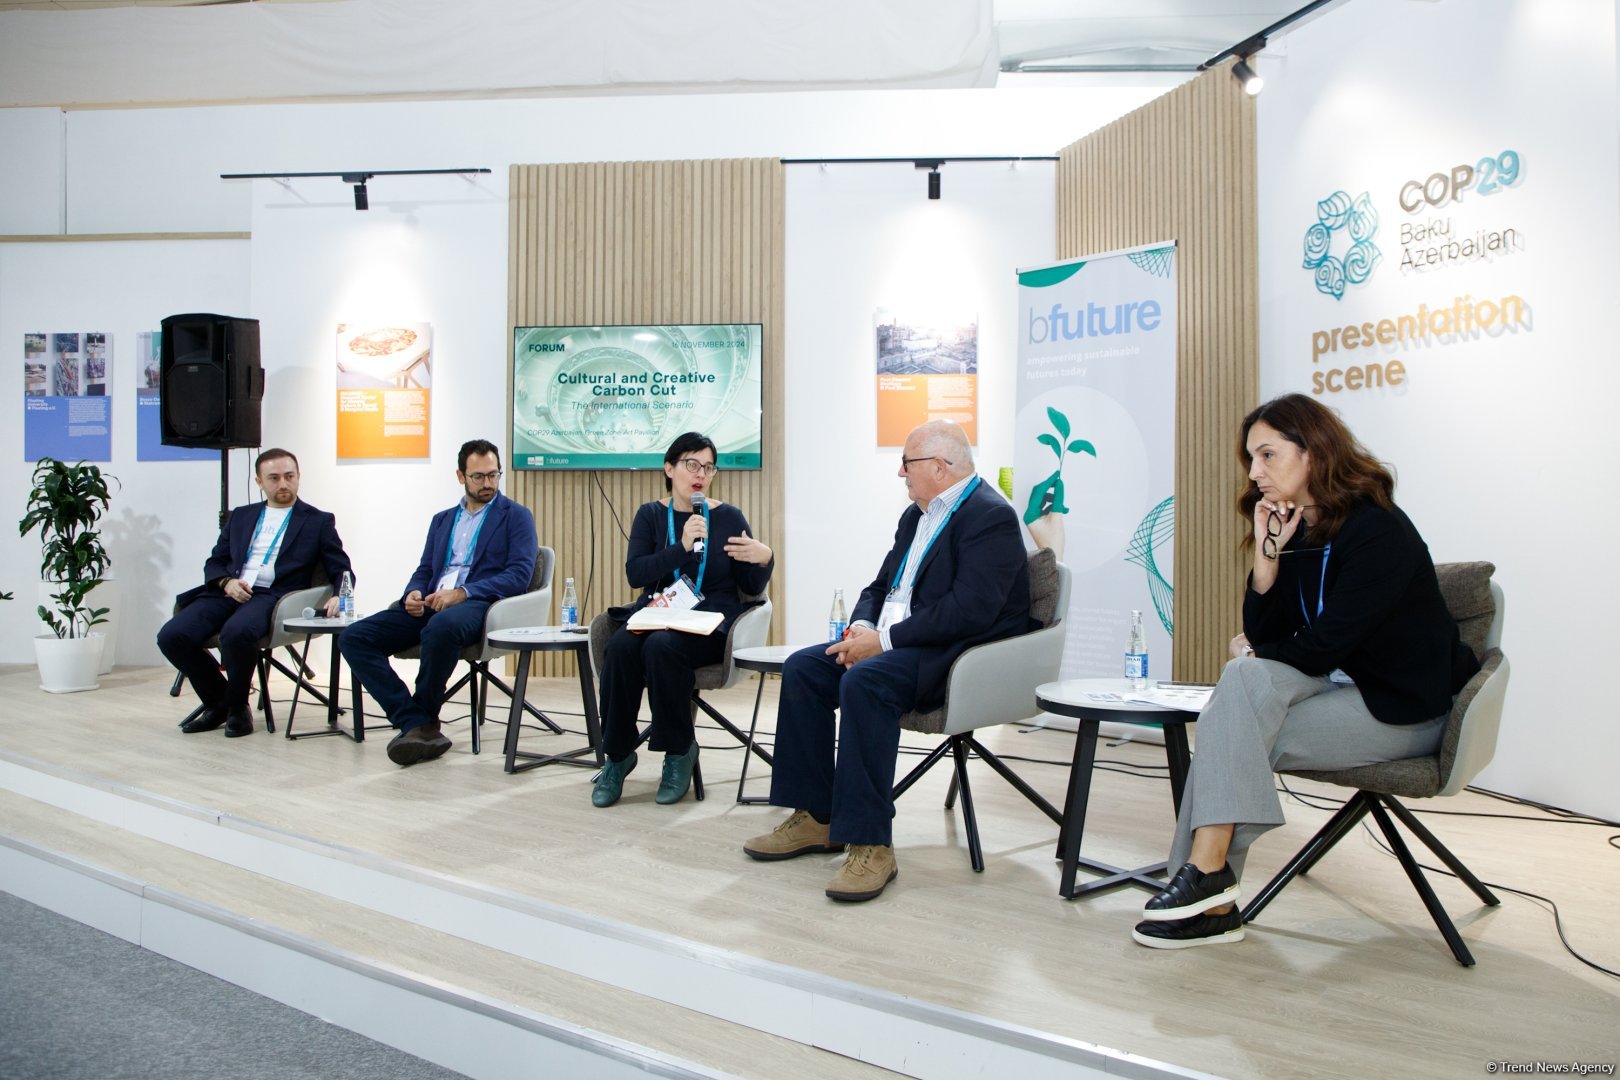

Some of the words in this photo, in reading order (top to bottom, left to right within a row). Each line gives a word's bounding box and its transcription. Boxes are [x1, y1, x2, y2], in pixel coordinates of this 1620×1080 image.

[1399, 150, 1520, 212] COP29
[1400, 217, 1451, 245] Baku
[1400, 228, 1516, 268] Azerbaijan
[1028, 300, 1162, 345] bfuture
[1312, 295, 1523, 362] presentation
[528, 343, 565, 352] FORUM
[726, 340, 745, 348] 2024
[1027, 350, 1083, 367] empowering
[1084, 345, 1140, 361] sustainable
[558, 372, 616, 384] Cultural
[621, 372, 648, 384] and
[652, 371, 716, 383] Creative
[1026, 369, 1060, 380] futures
[1060, 366, 1087, 378] today
[1312, 360, 1406, 395] scene
[592, 384, 645, 396] Carbon
[650, 384, 677, 396] Cut
[572, 401, 589, 409] The
[591, 401, 650, 410] International
[652, 400, 694, 409] Scenario
